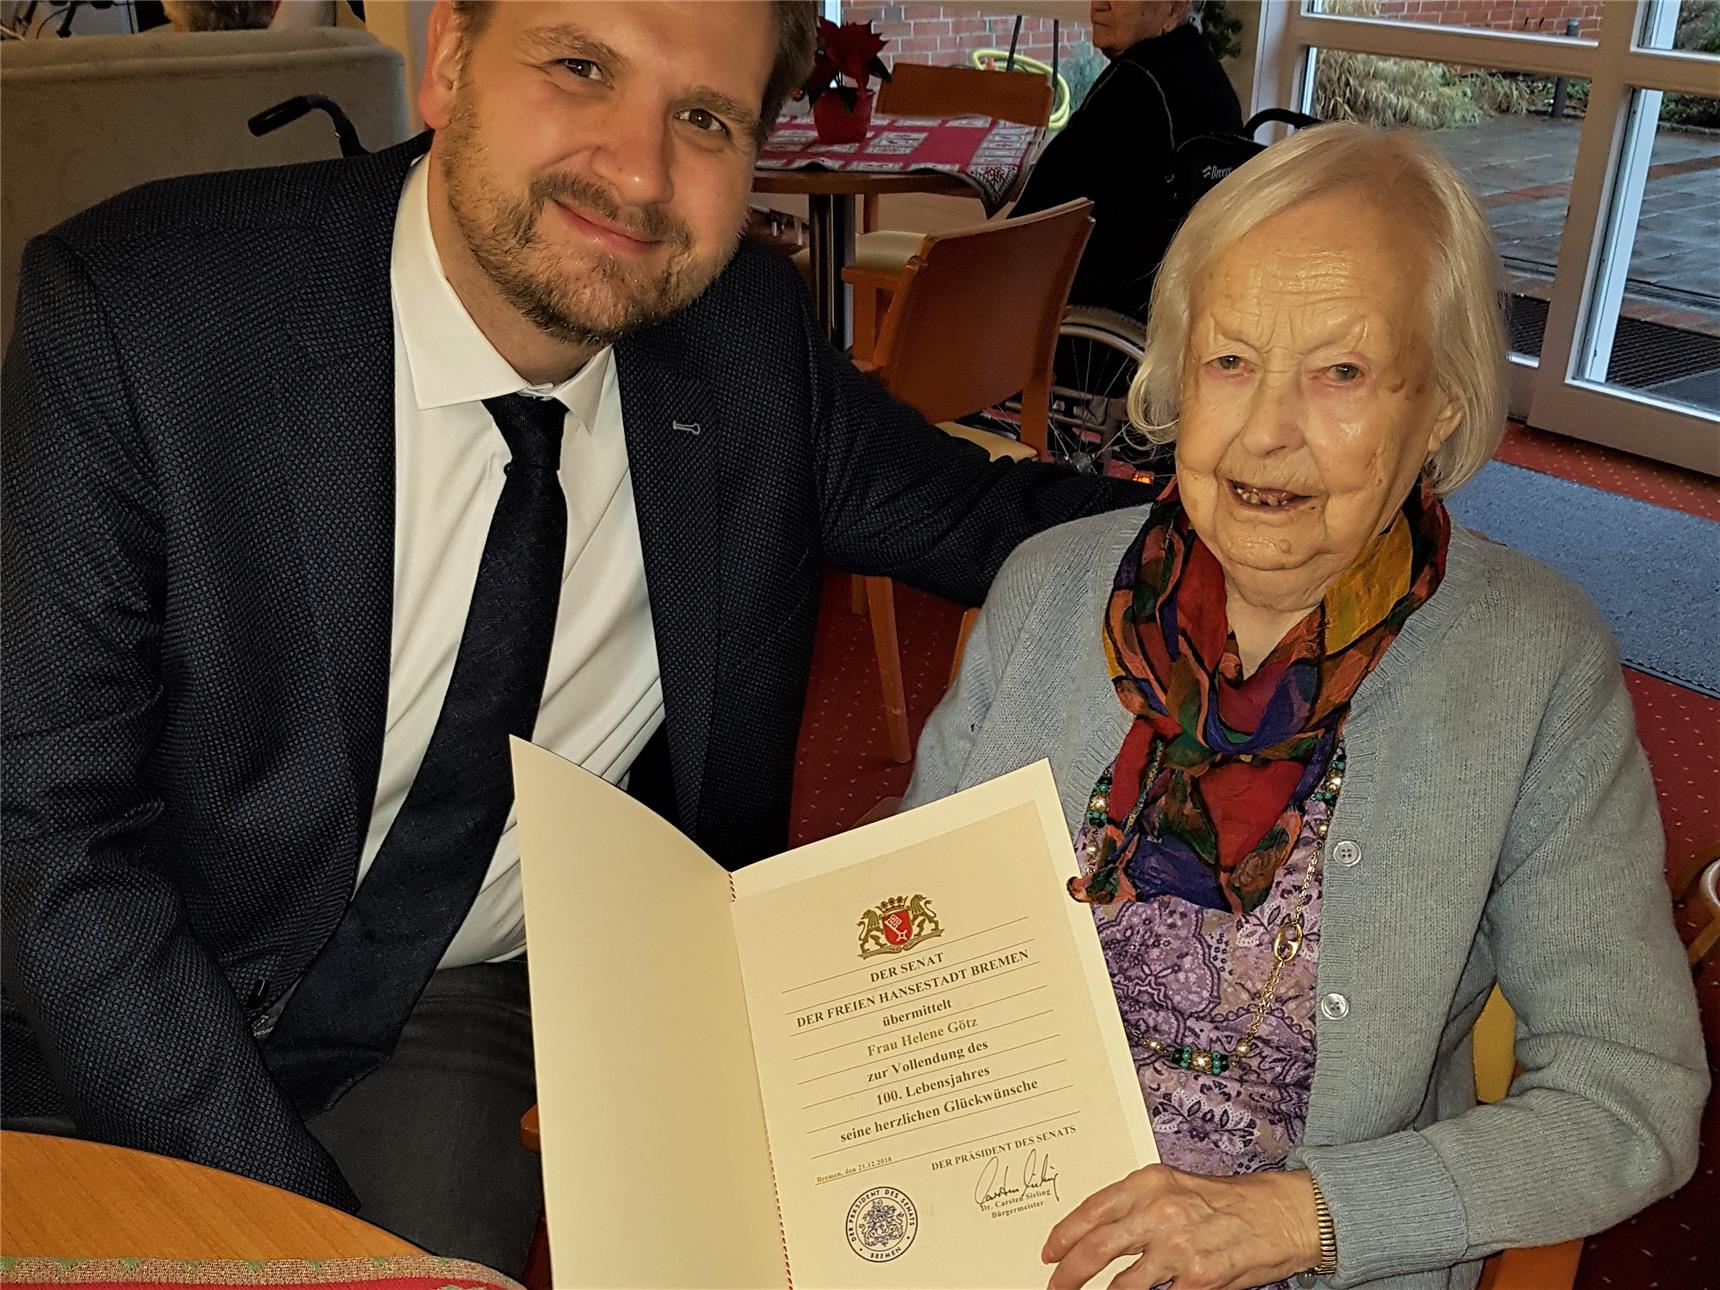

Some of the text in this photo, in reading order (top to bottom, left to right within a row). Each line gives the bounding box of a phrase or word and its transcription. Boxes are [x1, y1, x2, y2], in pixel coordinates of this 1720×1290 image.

[870, 952, 944, 983] DER SENAT
[796, 950, 1029, 1028] DER FREIEN HANSESTADT BREMEN
[882, 999, 952, 1028] übermittelt
[867, 1016, 979, 1057] Frau Helene Götz
[867, 1040, 989, 1083] zur Vollendung des
[877, 1066, 991, 1106] 100. Lebensjahres
[840, 1079, 1039, 1143] seine herzlichen Glückwünsche
[931, 1124, 1077, 1171] DER PRÄSIDENT DES SENATS
[991, 1200, 1044, 1218] Bürgermeister
[995, 1197, 1024, 1208] Carsten
